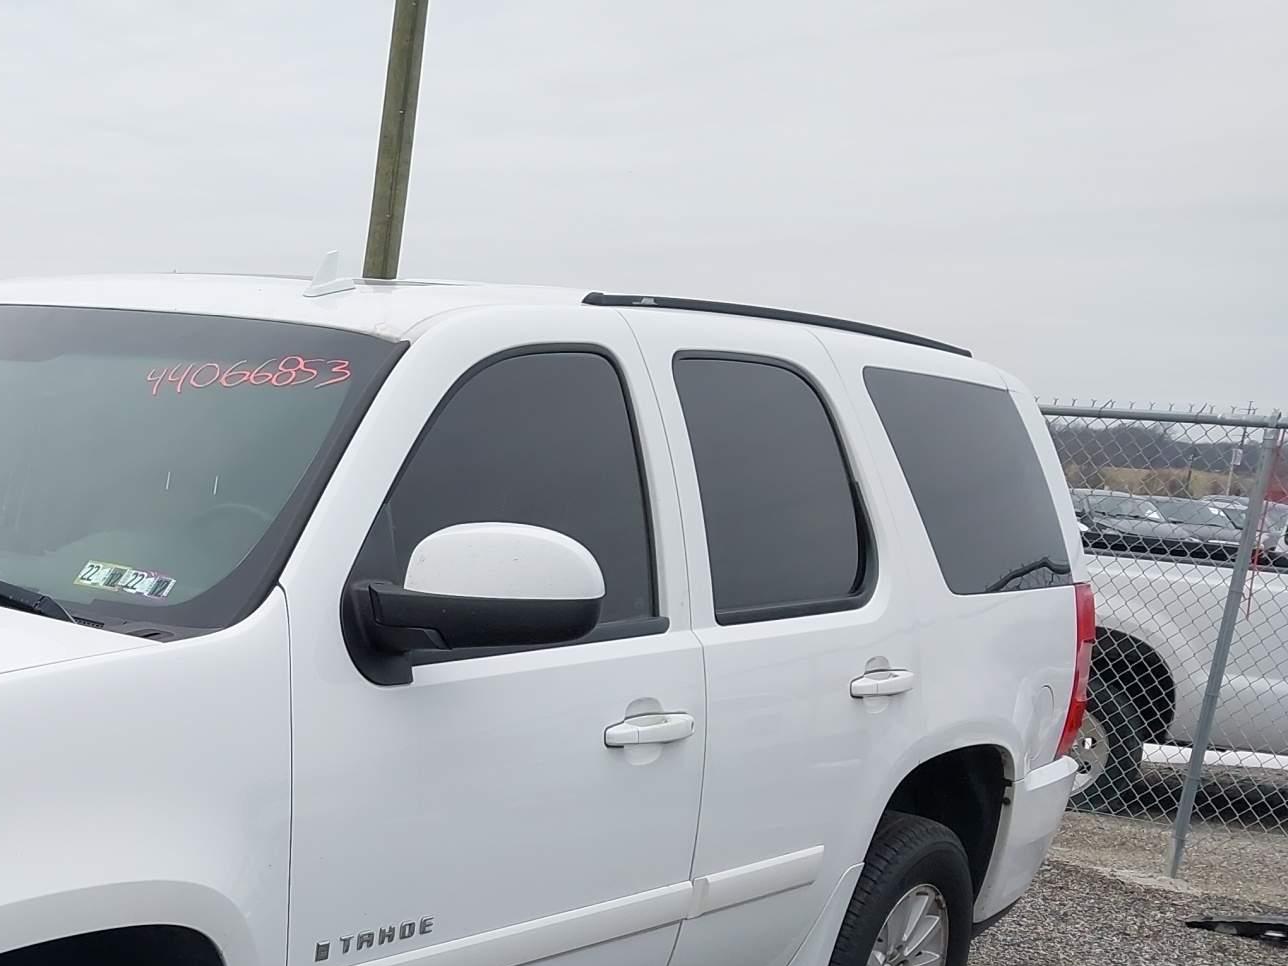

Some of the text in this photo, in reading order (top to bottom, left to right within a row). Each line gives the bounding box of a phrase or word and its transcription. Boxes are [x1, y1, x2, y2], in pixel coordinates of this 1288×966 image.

[147, 356, 351, 395] 44066853
[80, 564, 100, 581] 22
[123, 572, 145, 590] 22
[339, 915, 435, 955] TAHOE
